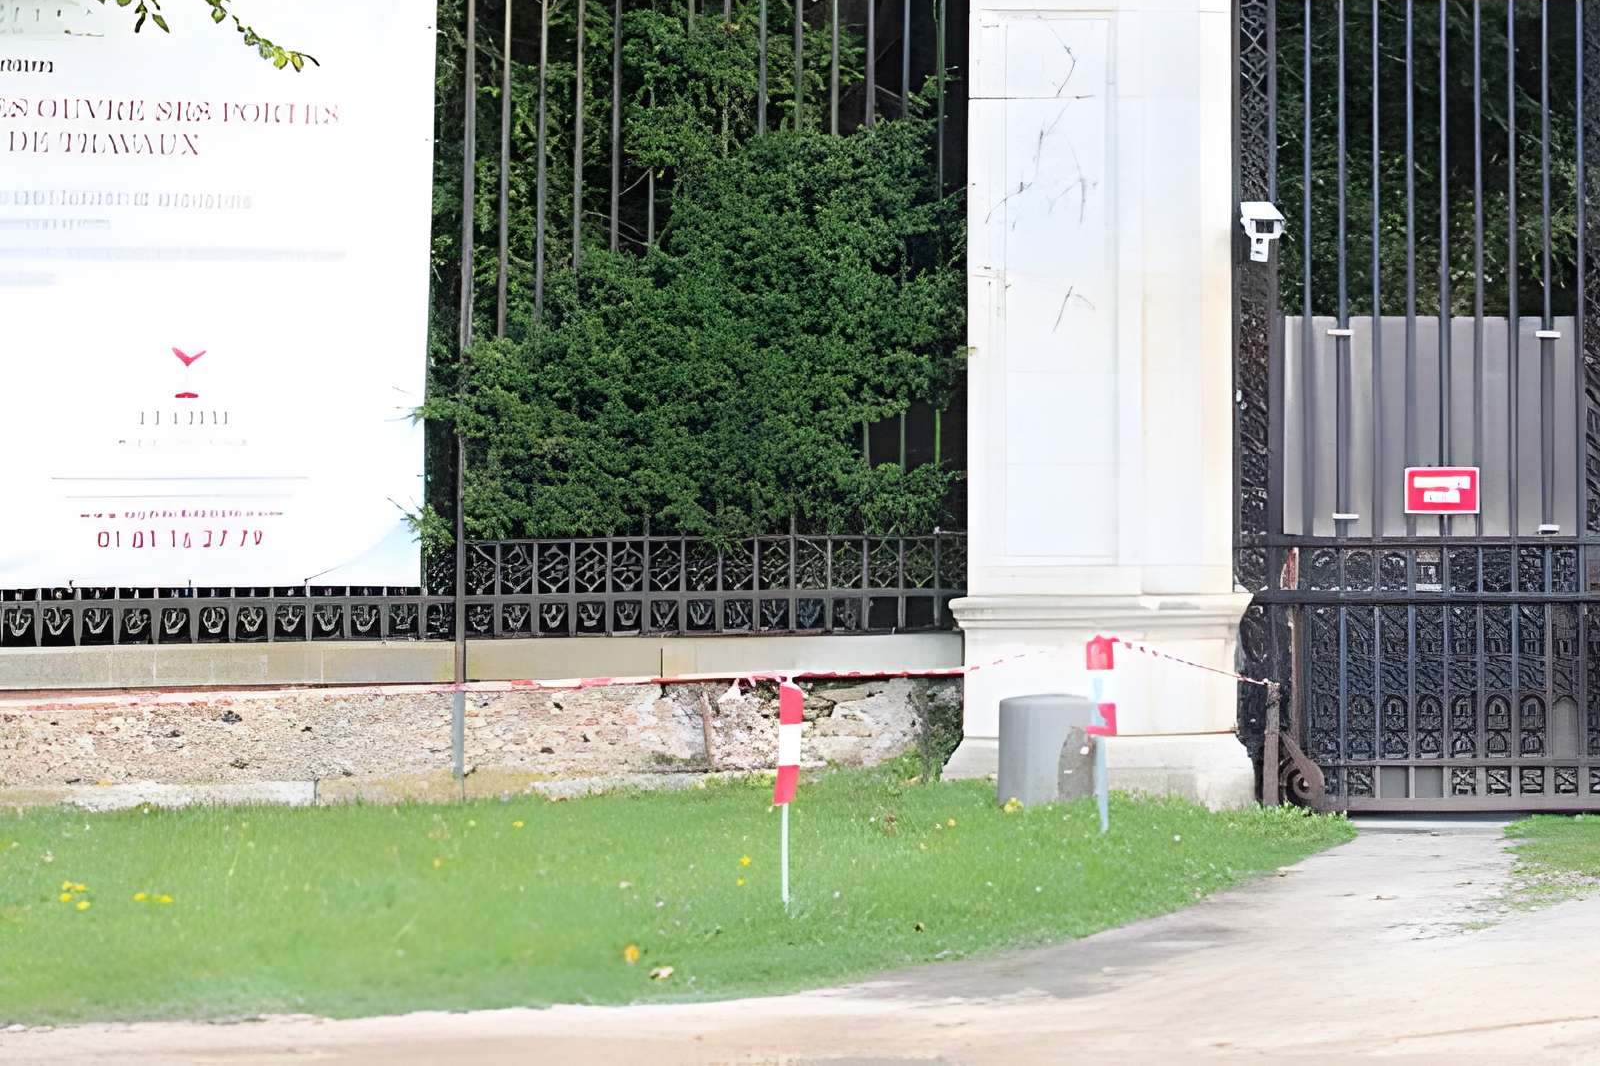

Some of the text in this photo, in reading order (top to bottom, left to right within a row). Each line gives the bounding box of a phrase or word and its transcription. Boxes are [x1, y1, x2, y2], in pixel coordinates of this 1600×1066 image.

[36, 98, 145, 123] OUVRE
[155, 100, 212, 123] SES
[223, 101, 340, 125] PORTES
[8, 130, 199, 156] DE TRAVAUX
